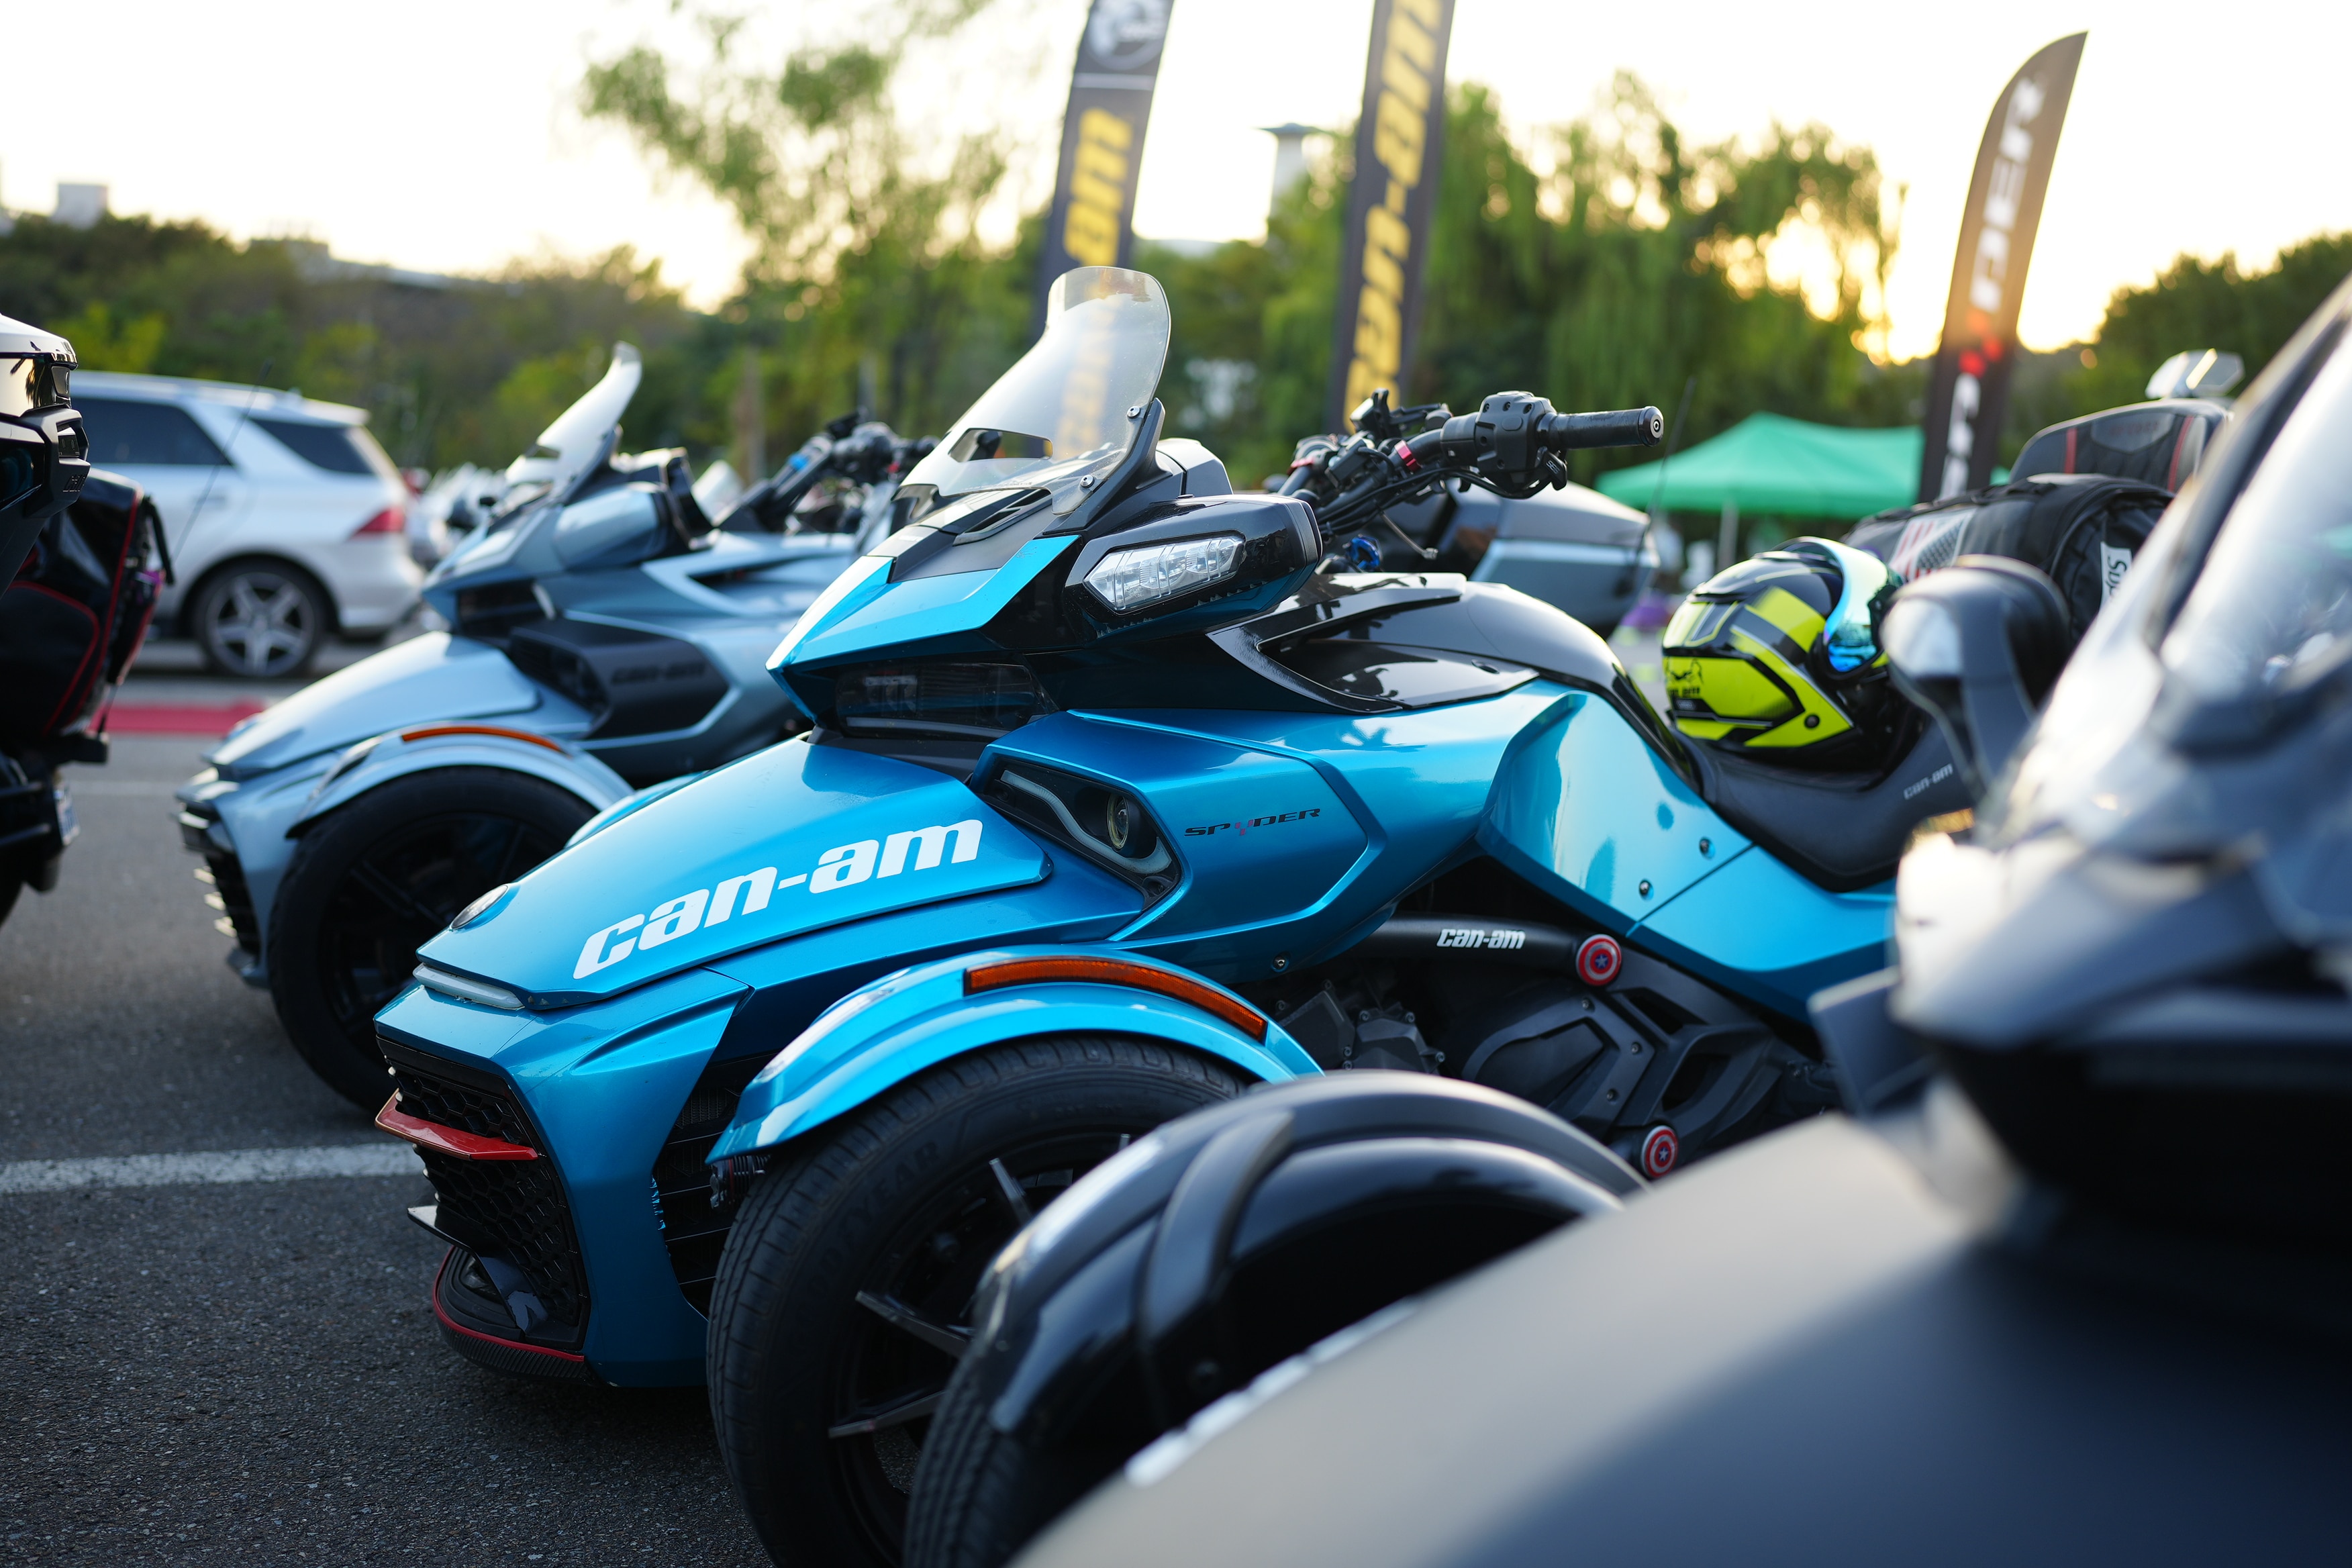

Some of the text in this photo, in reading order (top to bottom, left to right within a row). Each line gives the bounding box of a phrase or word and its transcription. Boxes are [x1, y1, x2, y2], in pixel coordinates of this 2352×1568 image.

[1903, 763, 1953, 800] can-am
[1184, 808, 1320, 836] SPYDER
[573, 819, 983, 980] can-am
[1436, 928, 1526, 949] can-am
